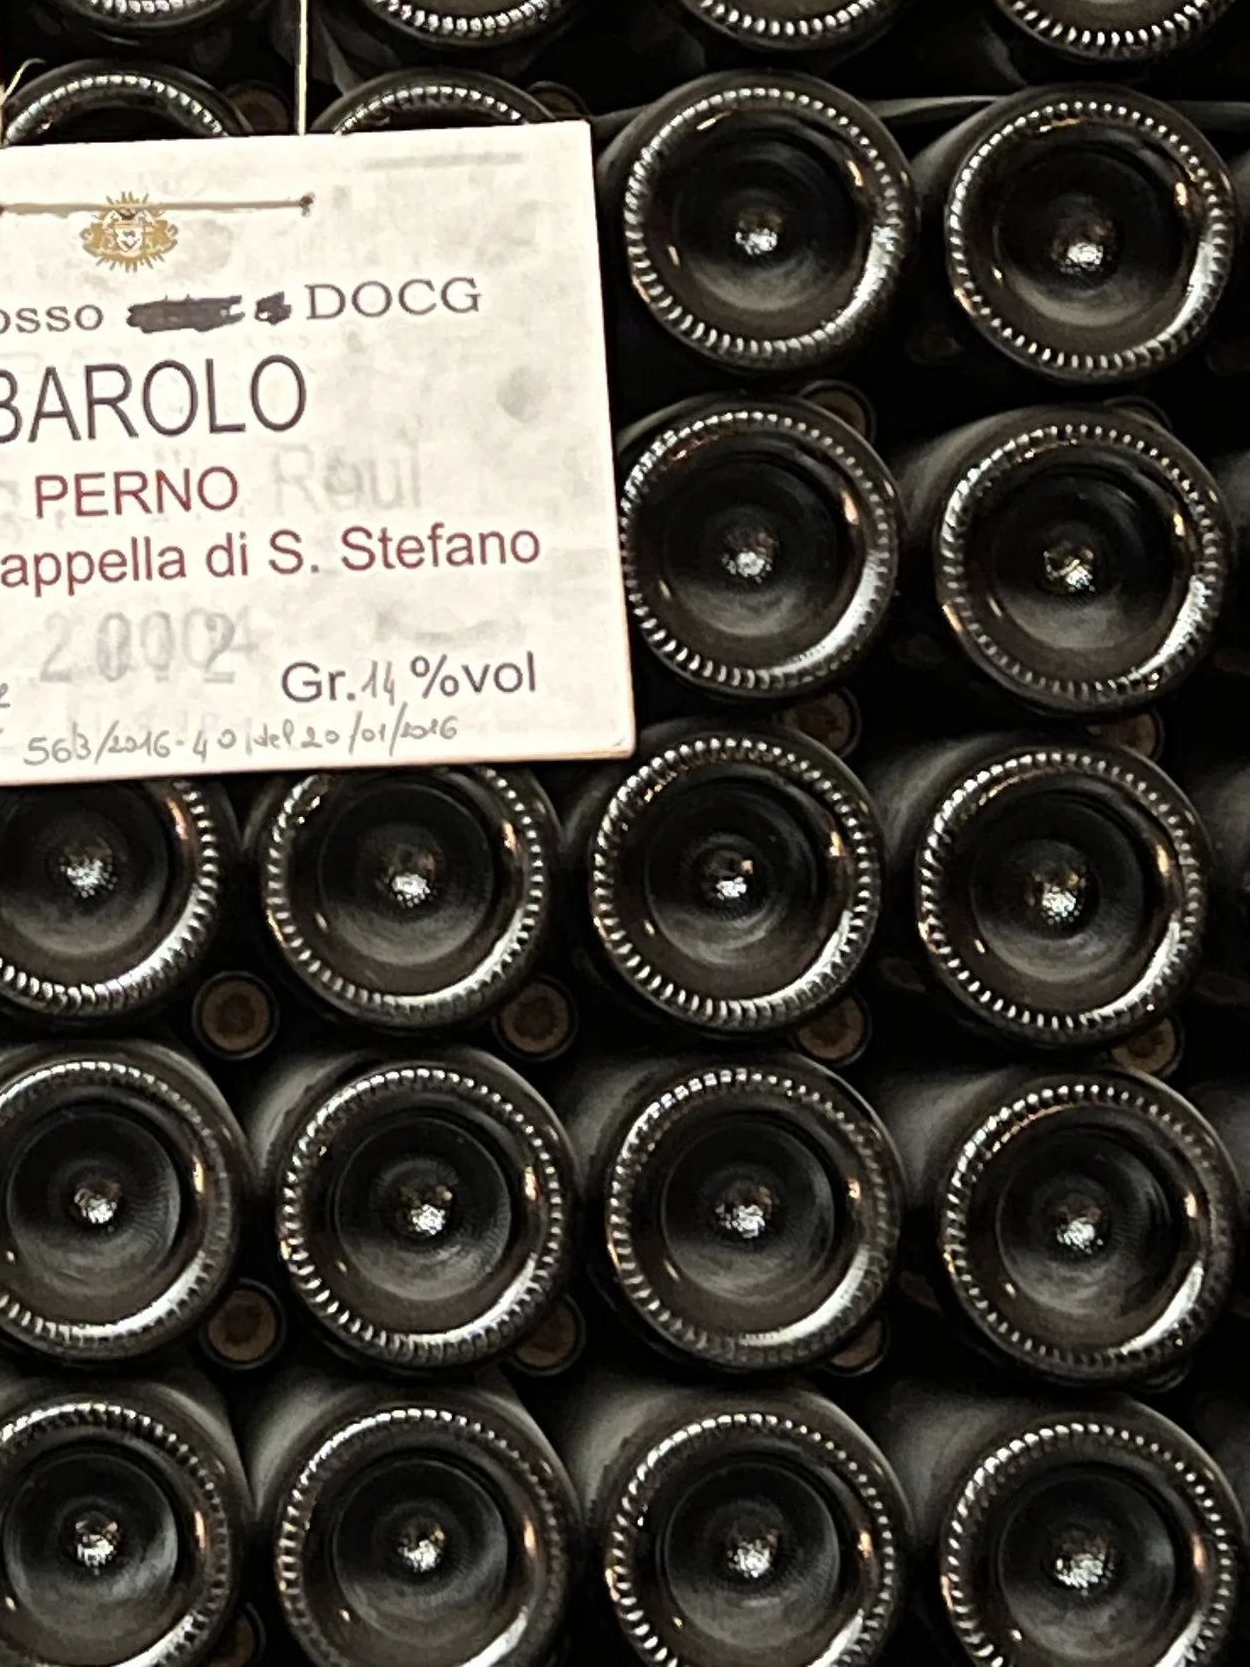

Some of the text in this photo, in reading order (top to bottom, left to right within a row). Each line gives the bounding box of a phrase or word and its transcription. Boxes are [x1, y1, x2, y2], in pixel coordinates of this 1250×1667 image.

[304, 277, 482, 321] DOCG
[33, 465, 240, 520] PERNO
[205, 531, 249, 577] di
[267, 528, 320, 575] S.
[340, 521, 541, 572] Stefano
